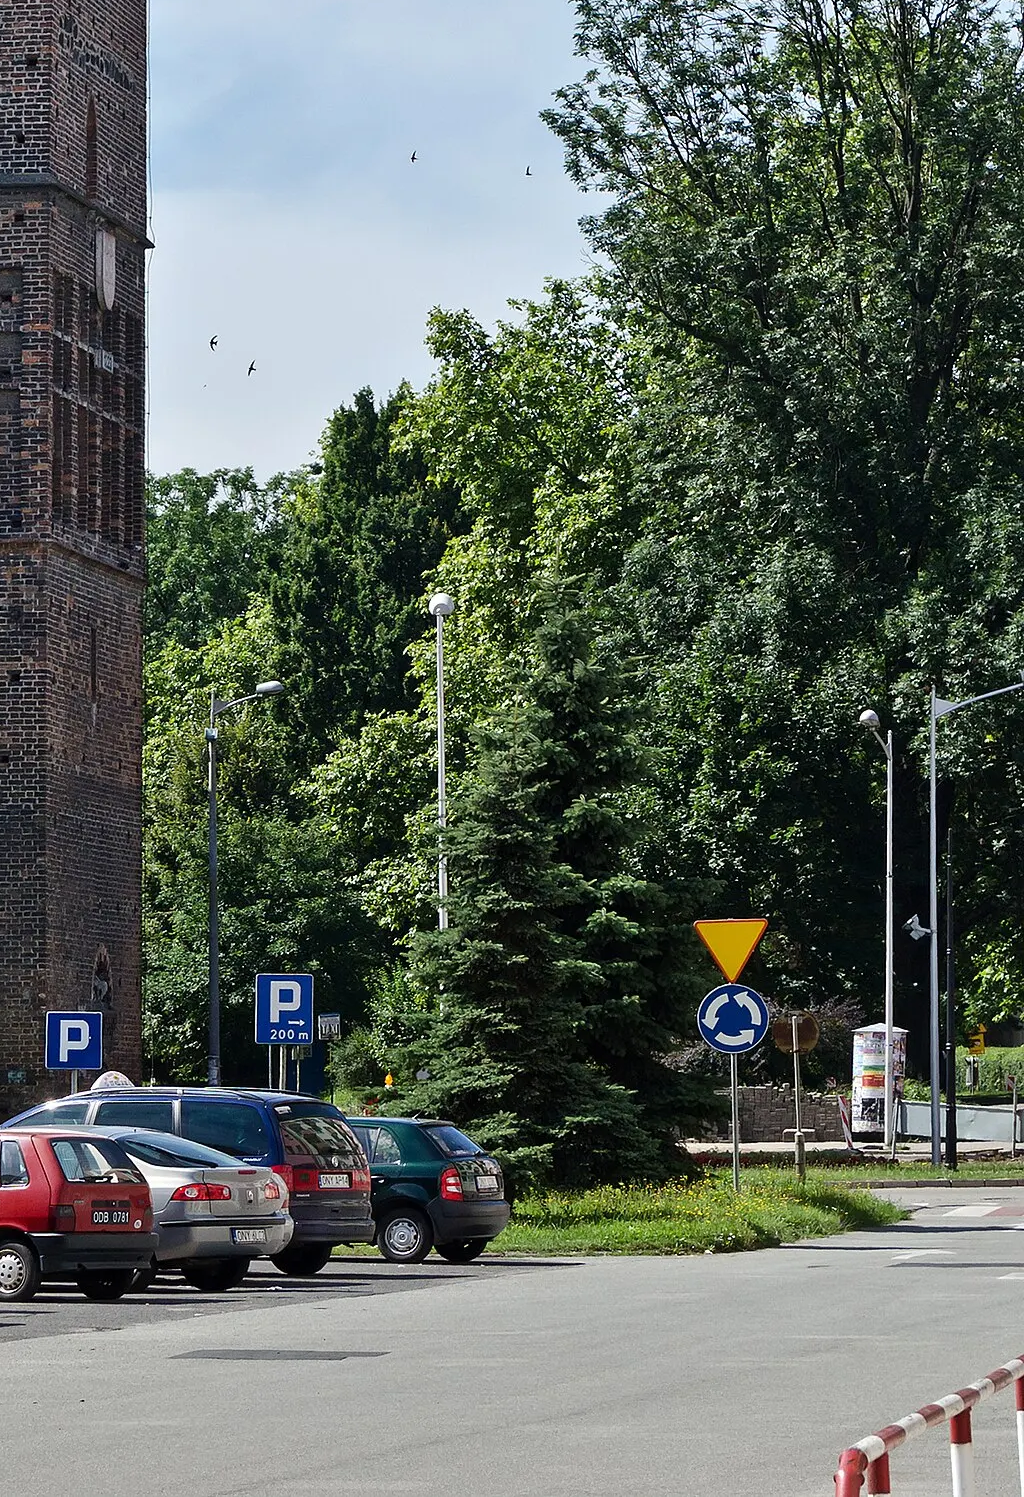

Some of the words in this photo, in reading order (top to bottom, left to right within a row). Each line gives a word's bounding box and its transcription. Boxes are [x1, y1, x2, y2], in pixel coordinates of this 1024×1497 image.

[270, 980, 301, 1023] P
[59, 1019, 90, 1063] P
[270, 1029, 295, 1040] 200
[298, 1032, 309, 1040] m
[93, 1211, 109, 1223] ODB
[112, 1211, 129, 1223] 0781
